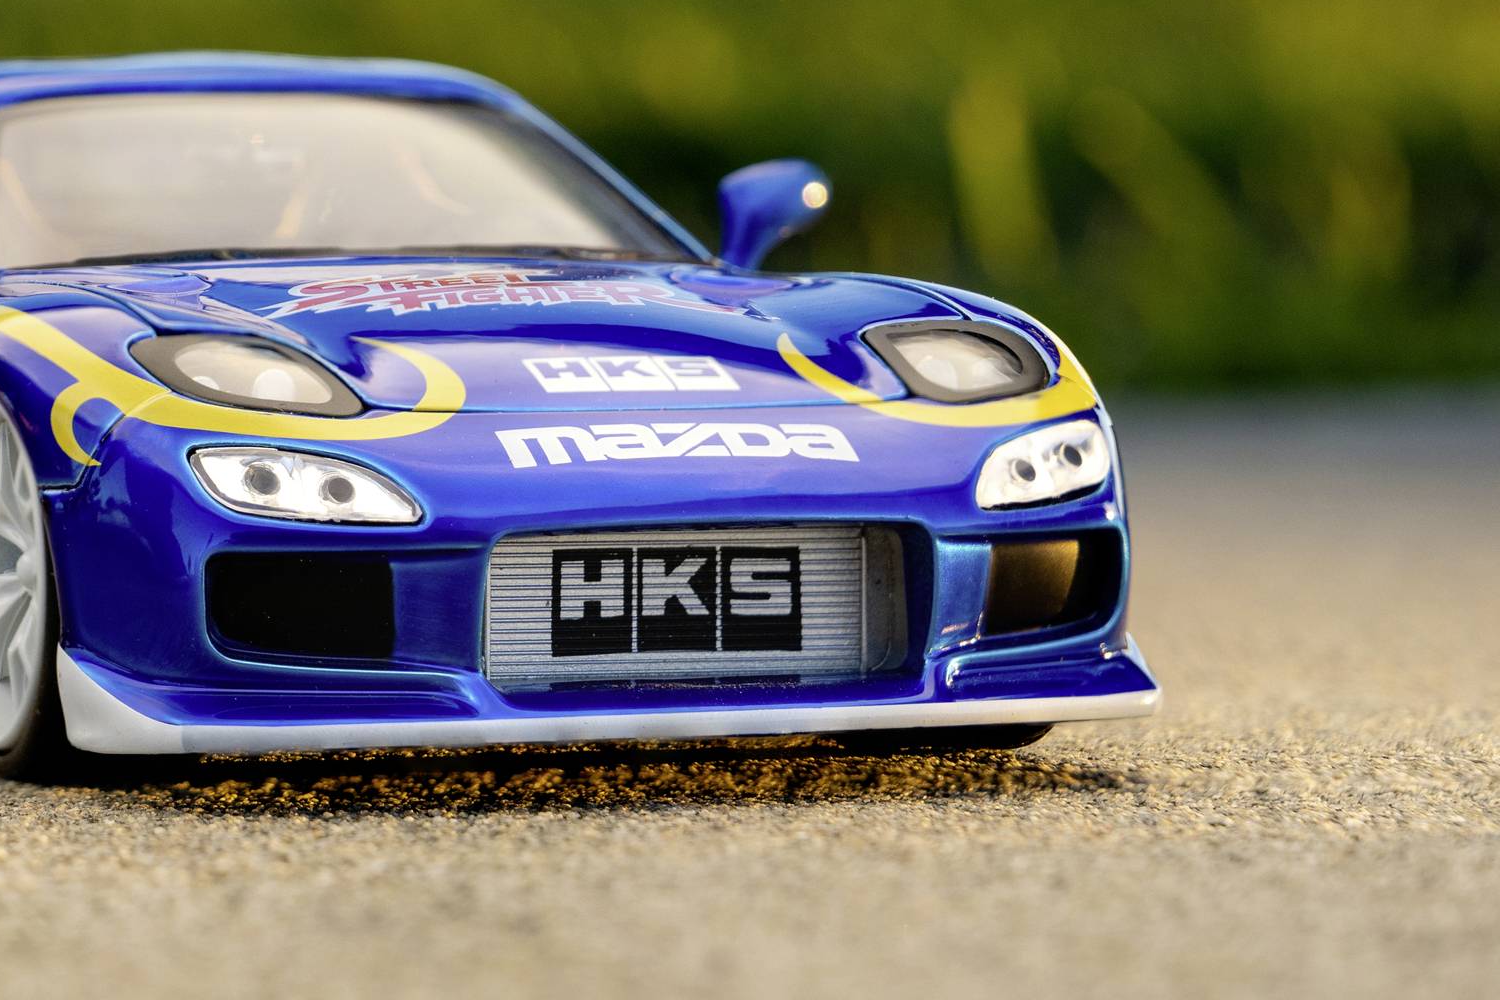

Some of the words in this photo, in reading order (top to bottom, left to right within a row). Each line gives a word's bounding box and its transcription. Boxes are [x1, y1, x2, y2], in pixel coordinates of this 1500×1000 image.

[289, 272, 529, 310] STREET
[352, 284, 718, 314] FIGHTER
[525, 357, 728, 385] HKS
[560, 557, 793, 620] HKS
